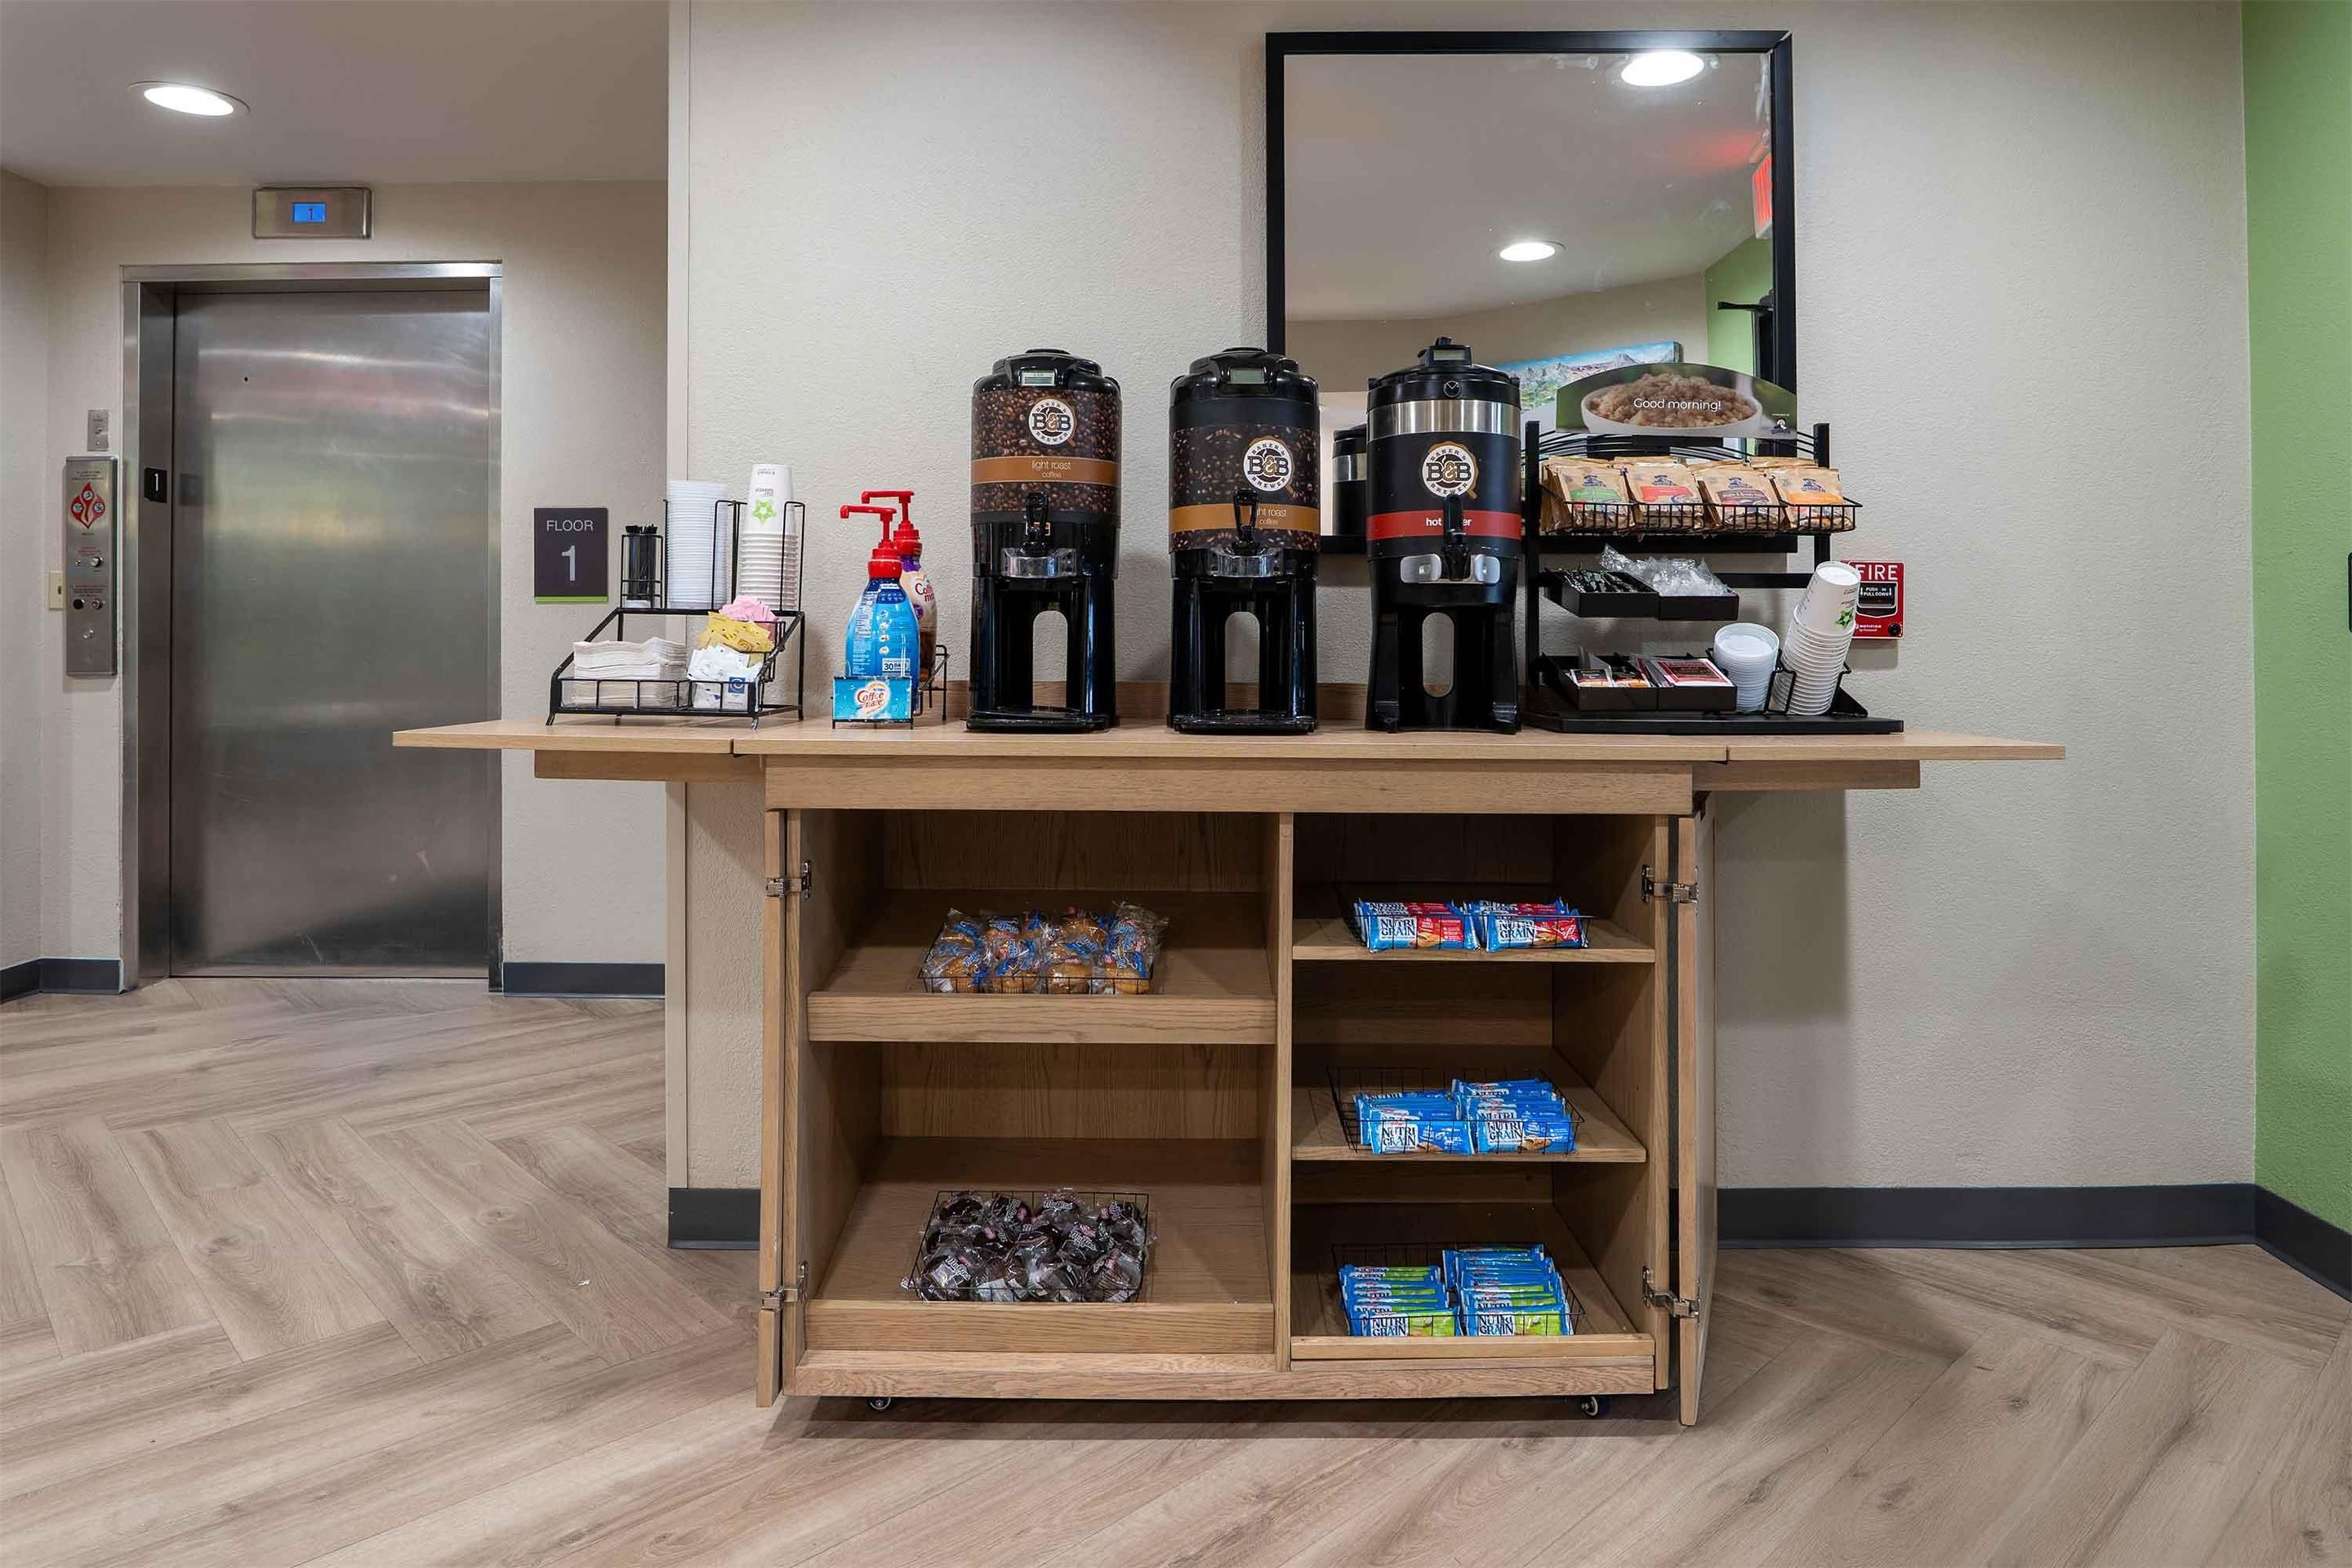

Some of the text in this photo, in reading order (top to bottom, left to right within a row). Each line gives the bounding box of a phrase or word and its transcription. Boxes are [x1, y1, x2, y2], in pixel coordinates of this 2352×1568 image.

[1633, 398, 1722, 412] Good morning!
[1031, 412, 1071, 432] B&B
[1251, 443, 1280, 456] BAKER
[1430, 448, 1460, 461] BAKER
[1031, 459, 1071, 471] light roast
[1247, 455, 1290, 478] B&B
[1426, 461, 1472, 483] B&B
[154, 473, 159, 492] 1
[1251, 476, 1287, 488] BREWER
[1431, 482, 1468, 495] BREWER
[1268, 509, 1287, 517] roast
[546, 519, 594, 532] FLOOR
[1426, 517, 1442, 527] hot
[561, 545, 576, 581] 1
[1855, 564, 1898, 581] FIRE
[884, 662, 894, 670] 30
[857, 689, 884, 704] Coffee
[1380, 919, 1415, 929] NUTRI
[1381, 926, 1415, 937] GRAIN
[1499, 926, 1535, 938] GRAIN
[1382, 1126, 1416, 1138] NUTRI
[1488, 1121, 1523, 1133] NUTRI
[1383, 1134, 1416, 1147] GRAIN
[1489, 1129, 1524, 1142] GRAIN
[1372, 1317, 1406, 1329] NUTRI
[1479, 1315, 1512, 1325] NUTRI
[1372, 1326, 1406, 1337] GRAIN
[1479, 1324, 1513, 1335] GRAIN
